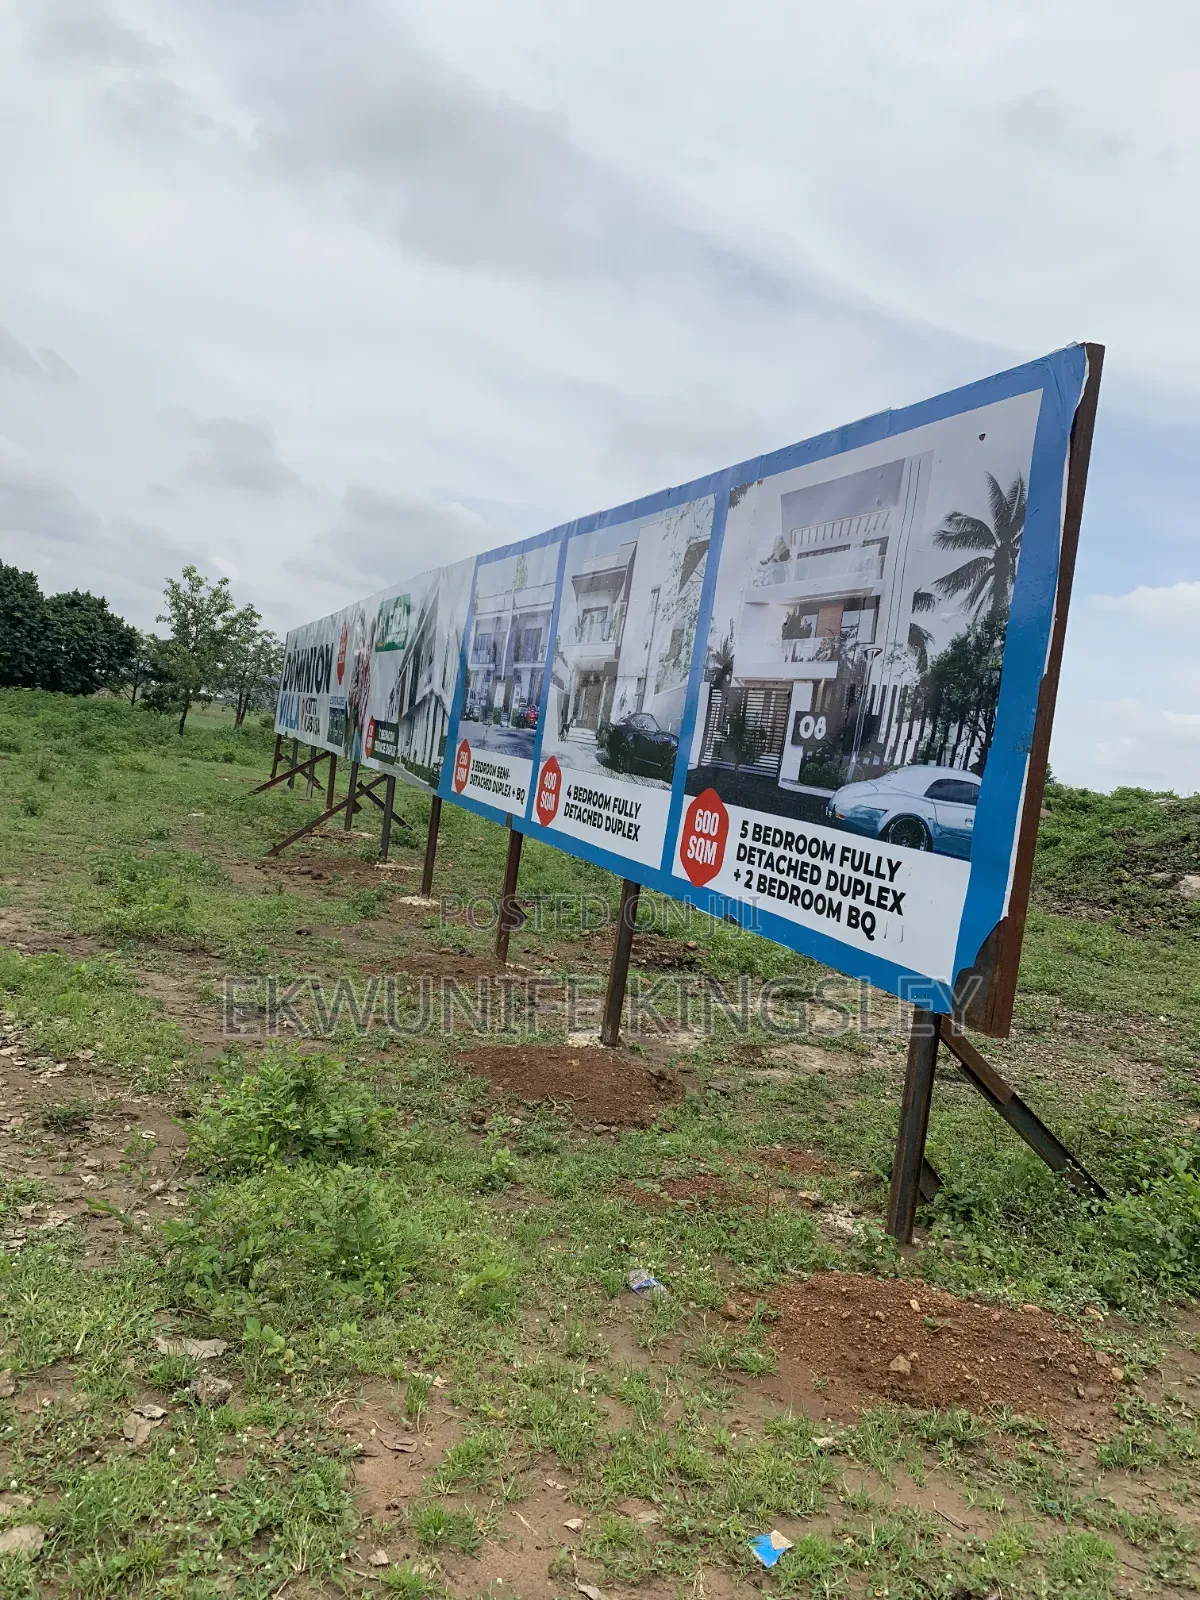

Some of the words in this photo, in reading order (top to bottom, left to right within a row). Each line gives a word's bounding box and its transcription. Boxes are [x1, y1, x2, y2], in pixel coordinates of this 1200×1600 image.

[283, 643, 334, 694] DOMINION
[799, 715, 826, 740] 08
[475, 760, 498, 778] BEDROOM
[543, 771, 557, 789] 400
[469, 774, 492, 792] DETACHED
[492, 780, 511, 798] DUPLEX
[516, 788, 525, 805] BQ
[540, 792, 556, 812] SQM
[566, 784, 572, 799] 4
[573, 787, 612, 812] BEDROOM
[612, 797, 642, 819] FULLY
[563, 802, 604, 831] DETACHED
[604, 817, 641, 842] DUPLEX
[695, 809, 720, 836] 600
[687, 835, 718, 866] SQM
[740, 820, 749, 838] 5
[752, 823, 837, 863] BEDROOM
[839, 846, 902, 883] FULLY
[736, 843, 822, 886] DETACHED
[825, 870, 907, 916] DUPLEX
[733, 869, 741, 882] +
[744, 870, 753, 889] 2
[756, 873, 843, 923] BEDROOM
[847, 906, 876, 941] BQ
